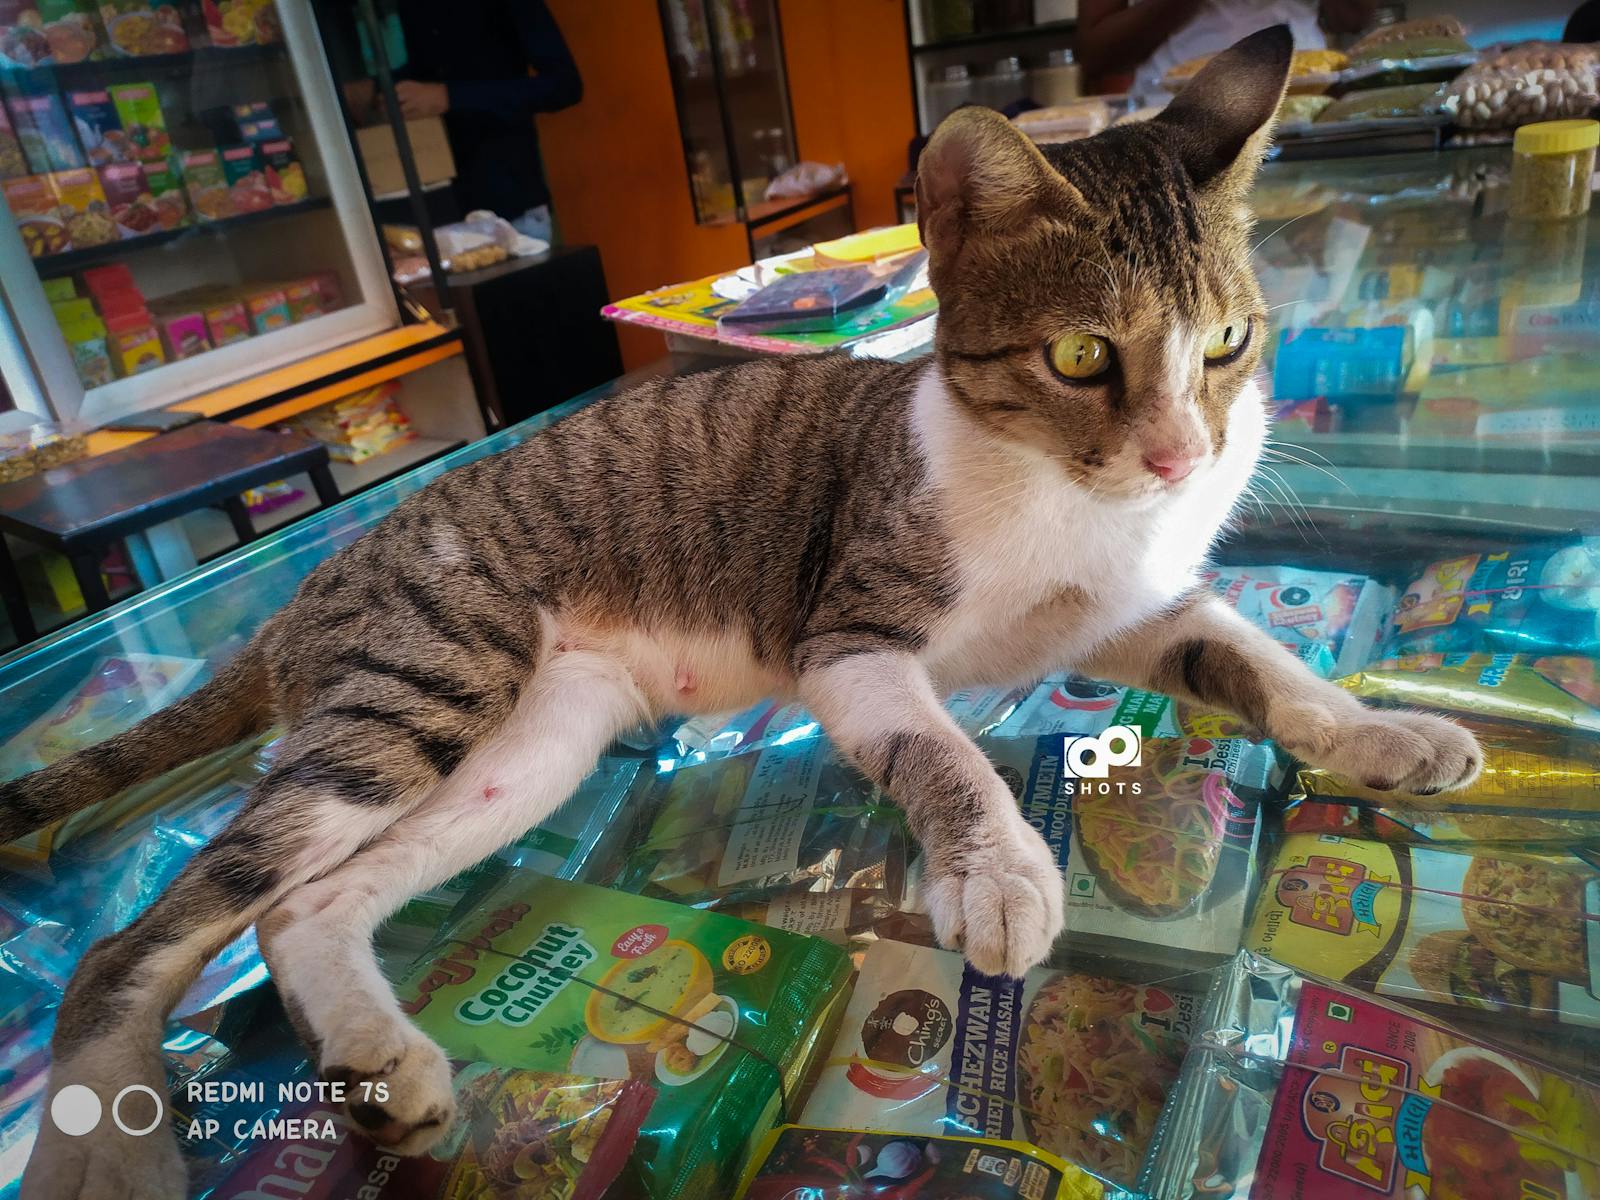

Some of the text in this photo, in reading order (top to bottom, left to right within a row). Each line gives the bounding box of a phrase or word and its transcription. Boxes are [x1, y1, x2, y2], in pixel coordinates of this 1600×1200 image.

[1210, 738, 1231, 771] Desi
[1031, 755, 1059, 833] OWMEIN
[631, 933, 657, 956] Fresh
[460, 925, 578, 1021] Coconut
[502, 943, 592, 1023] Chutney
[908, 998, 942, 1065] Ching's
[933, 1017, 948, 1049] SECRET
[1172, 994, 1194, 1036] Desi
[1386, 1021, 1400, 1050] SINCE
[956, 985, 992, 1131] SCHEZWAN
[990, 1049, 1009, 1092] RICE
[985, 1097, 1004, 1139] RIED
